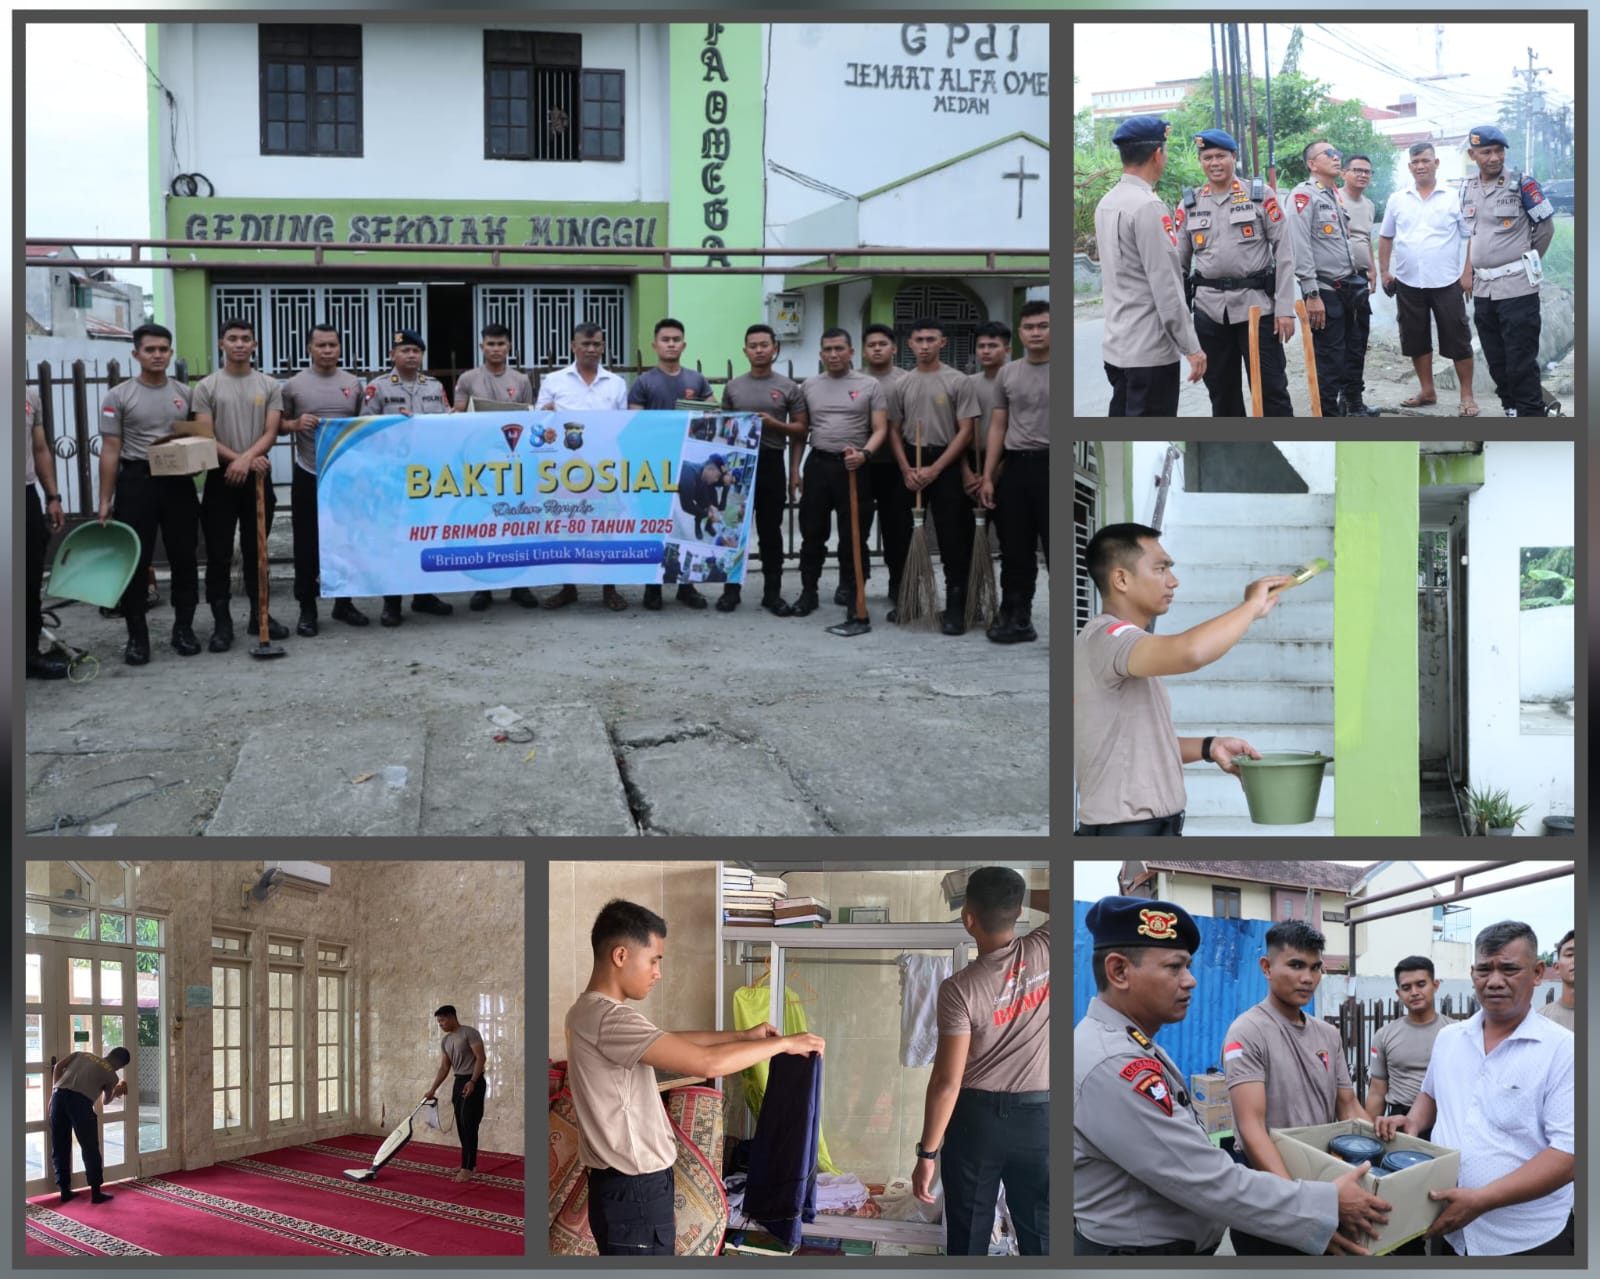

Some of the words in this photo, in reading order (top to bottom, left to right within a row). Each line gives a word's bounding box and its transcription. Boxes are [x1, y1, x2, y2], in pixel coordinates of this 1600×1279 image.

[845, 62, 935, 91] JEMAAT
[939, 68, 998, 94] ALFA
[1003, 71, 1050, 98] OME
[933, 95, 990, 115] MEDAN
[1230, 204, 1254, 213] POLRI
[184, 213, 335, 242] GEDUNG
[522, 215, 657, 248] MINGGU
[407, 461, 523, 498] BAKTI
[537, 459, 680, 493] SOSIAL
[492, 500, 543, 517] Dalam
[543, 498, 594, 518] Rangka
[409, 525, 438, 541] HUT
[441, 523, 497, 540] BRIMOB
[501, 521, 540, 537] POLRI
[544, 520, 586, 535] KE-80
[591, 519, 636, 534] TAHUN
[639, 519, 674, 534] 2025
[428, 553, 484, 567] "Brimob
[487, 549, 529, 563] Presisi
[532, 547, 572, 560] Untuk
[574, 546, 657, 562] Masyarakat"
